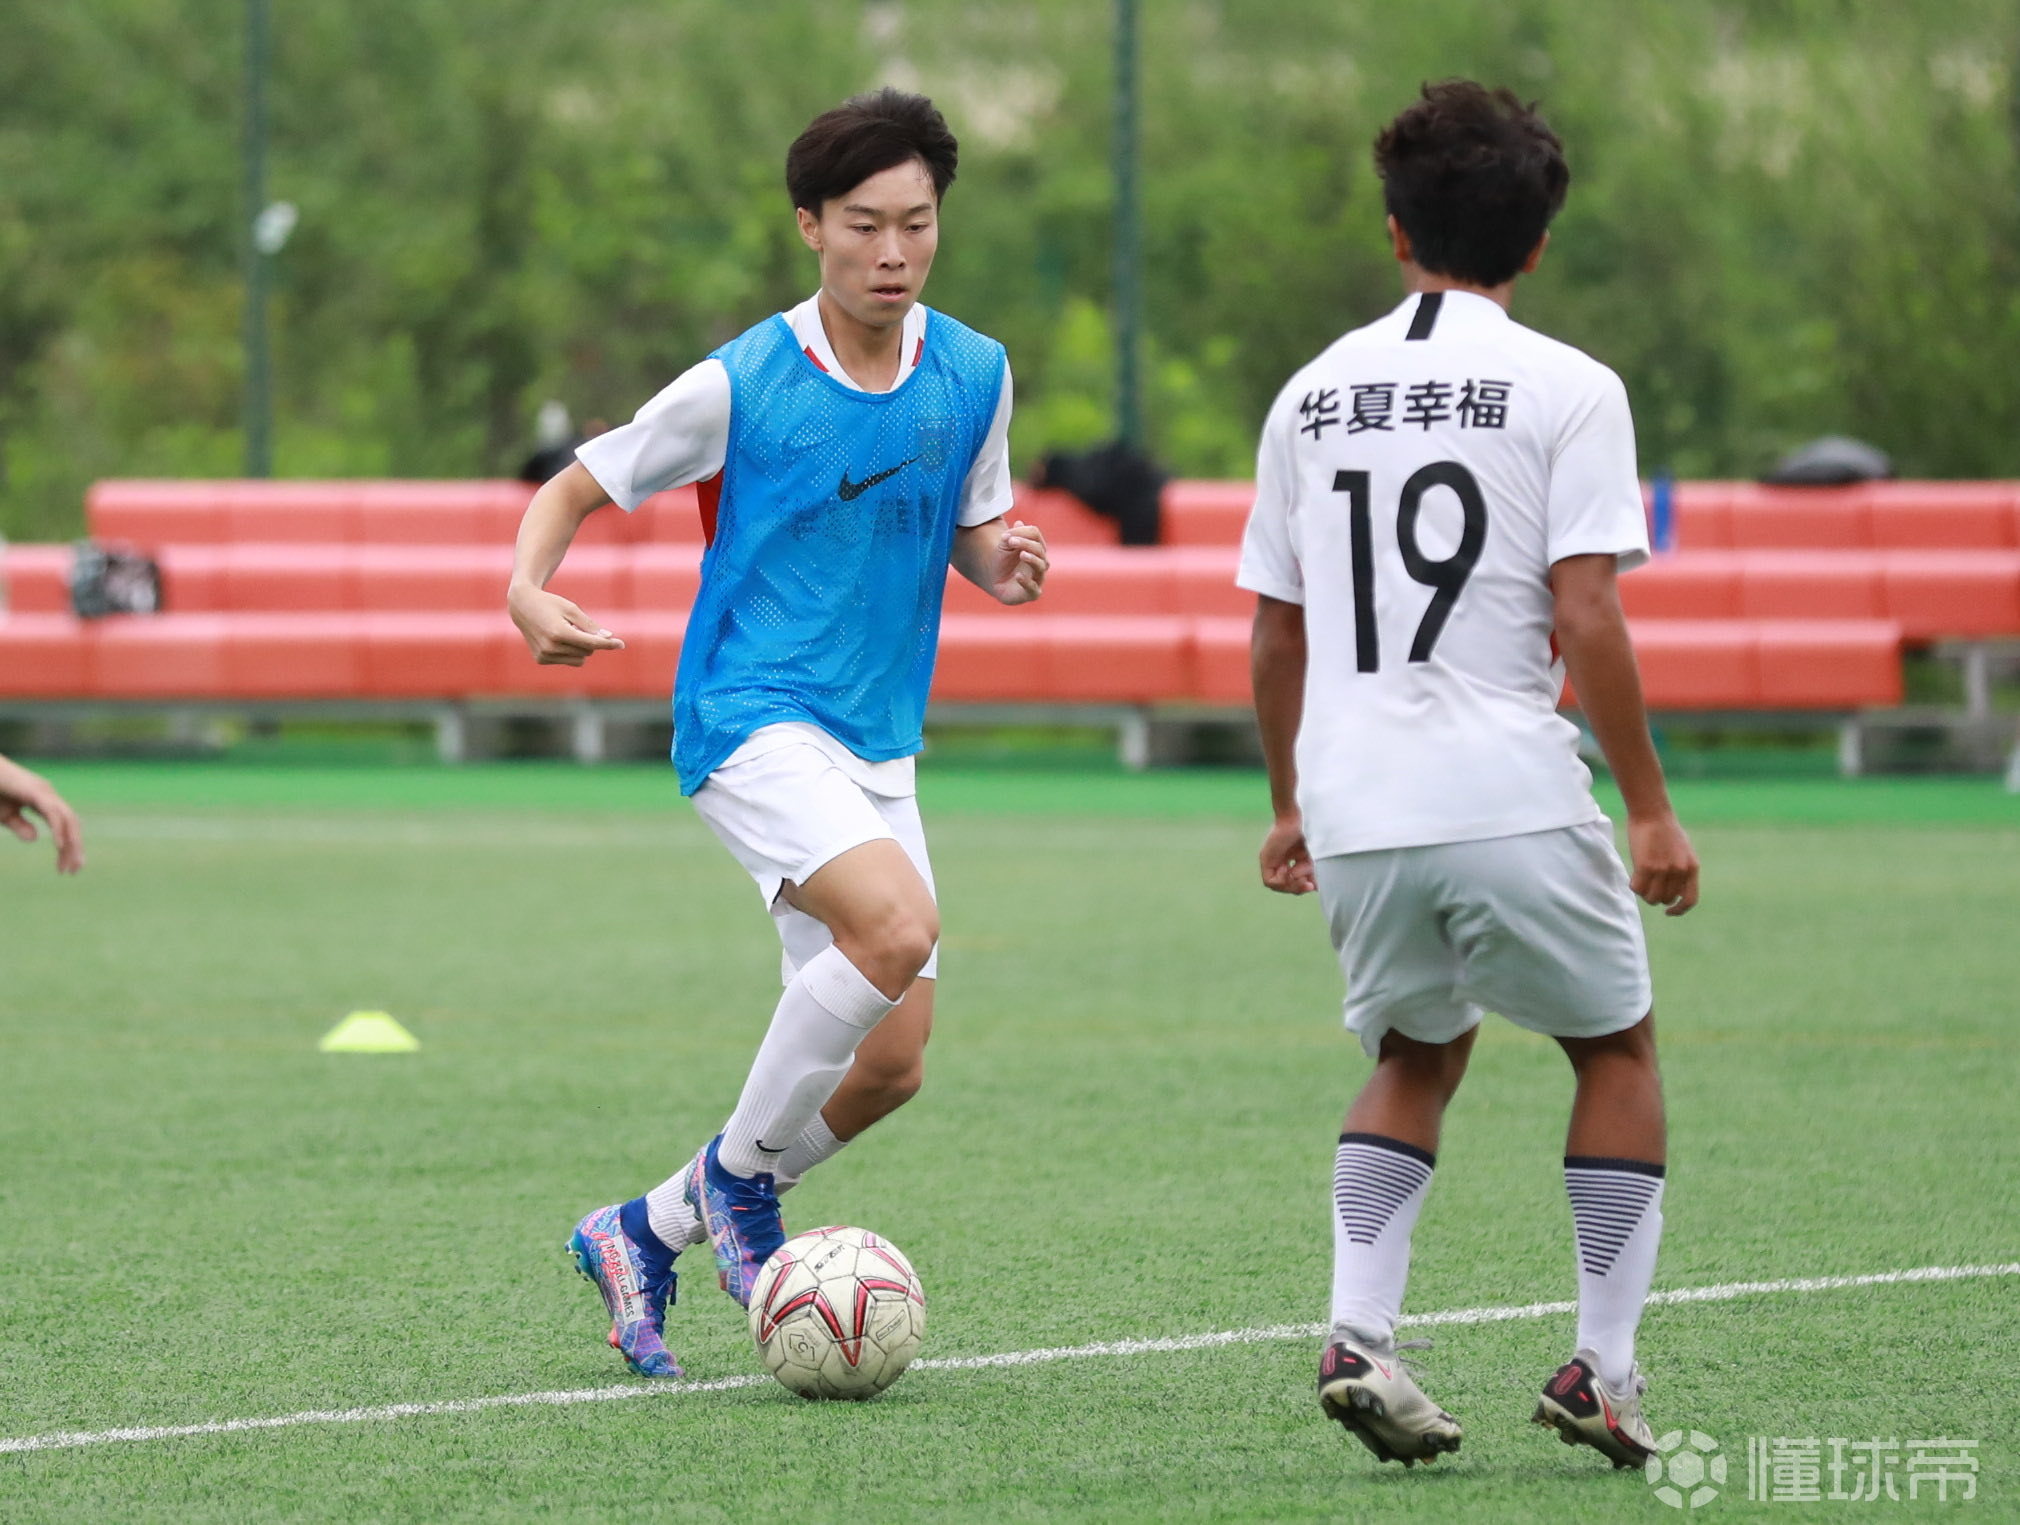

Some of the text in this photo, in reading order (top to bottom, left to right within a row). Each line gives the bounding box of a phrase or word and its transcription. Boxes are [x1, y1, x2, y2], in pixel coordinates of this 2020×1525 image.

[1300, 379, 1513, 441] 华夏幸福
[1332, 461, 1489, 674] 19
